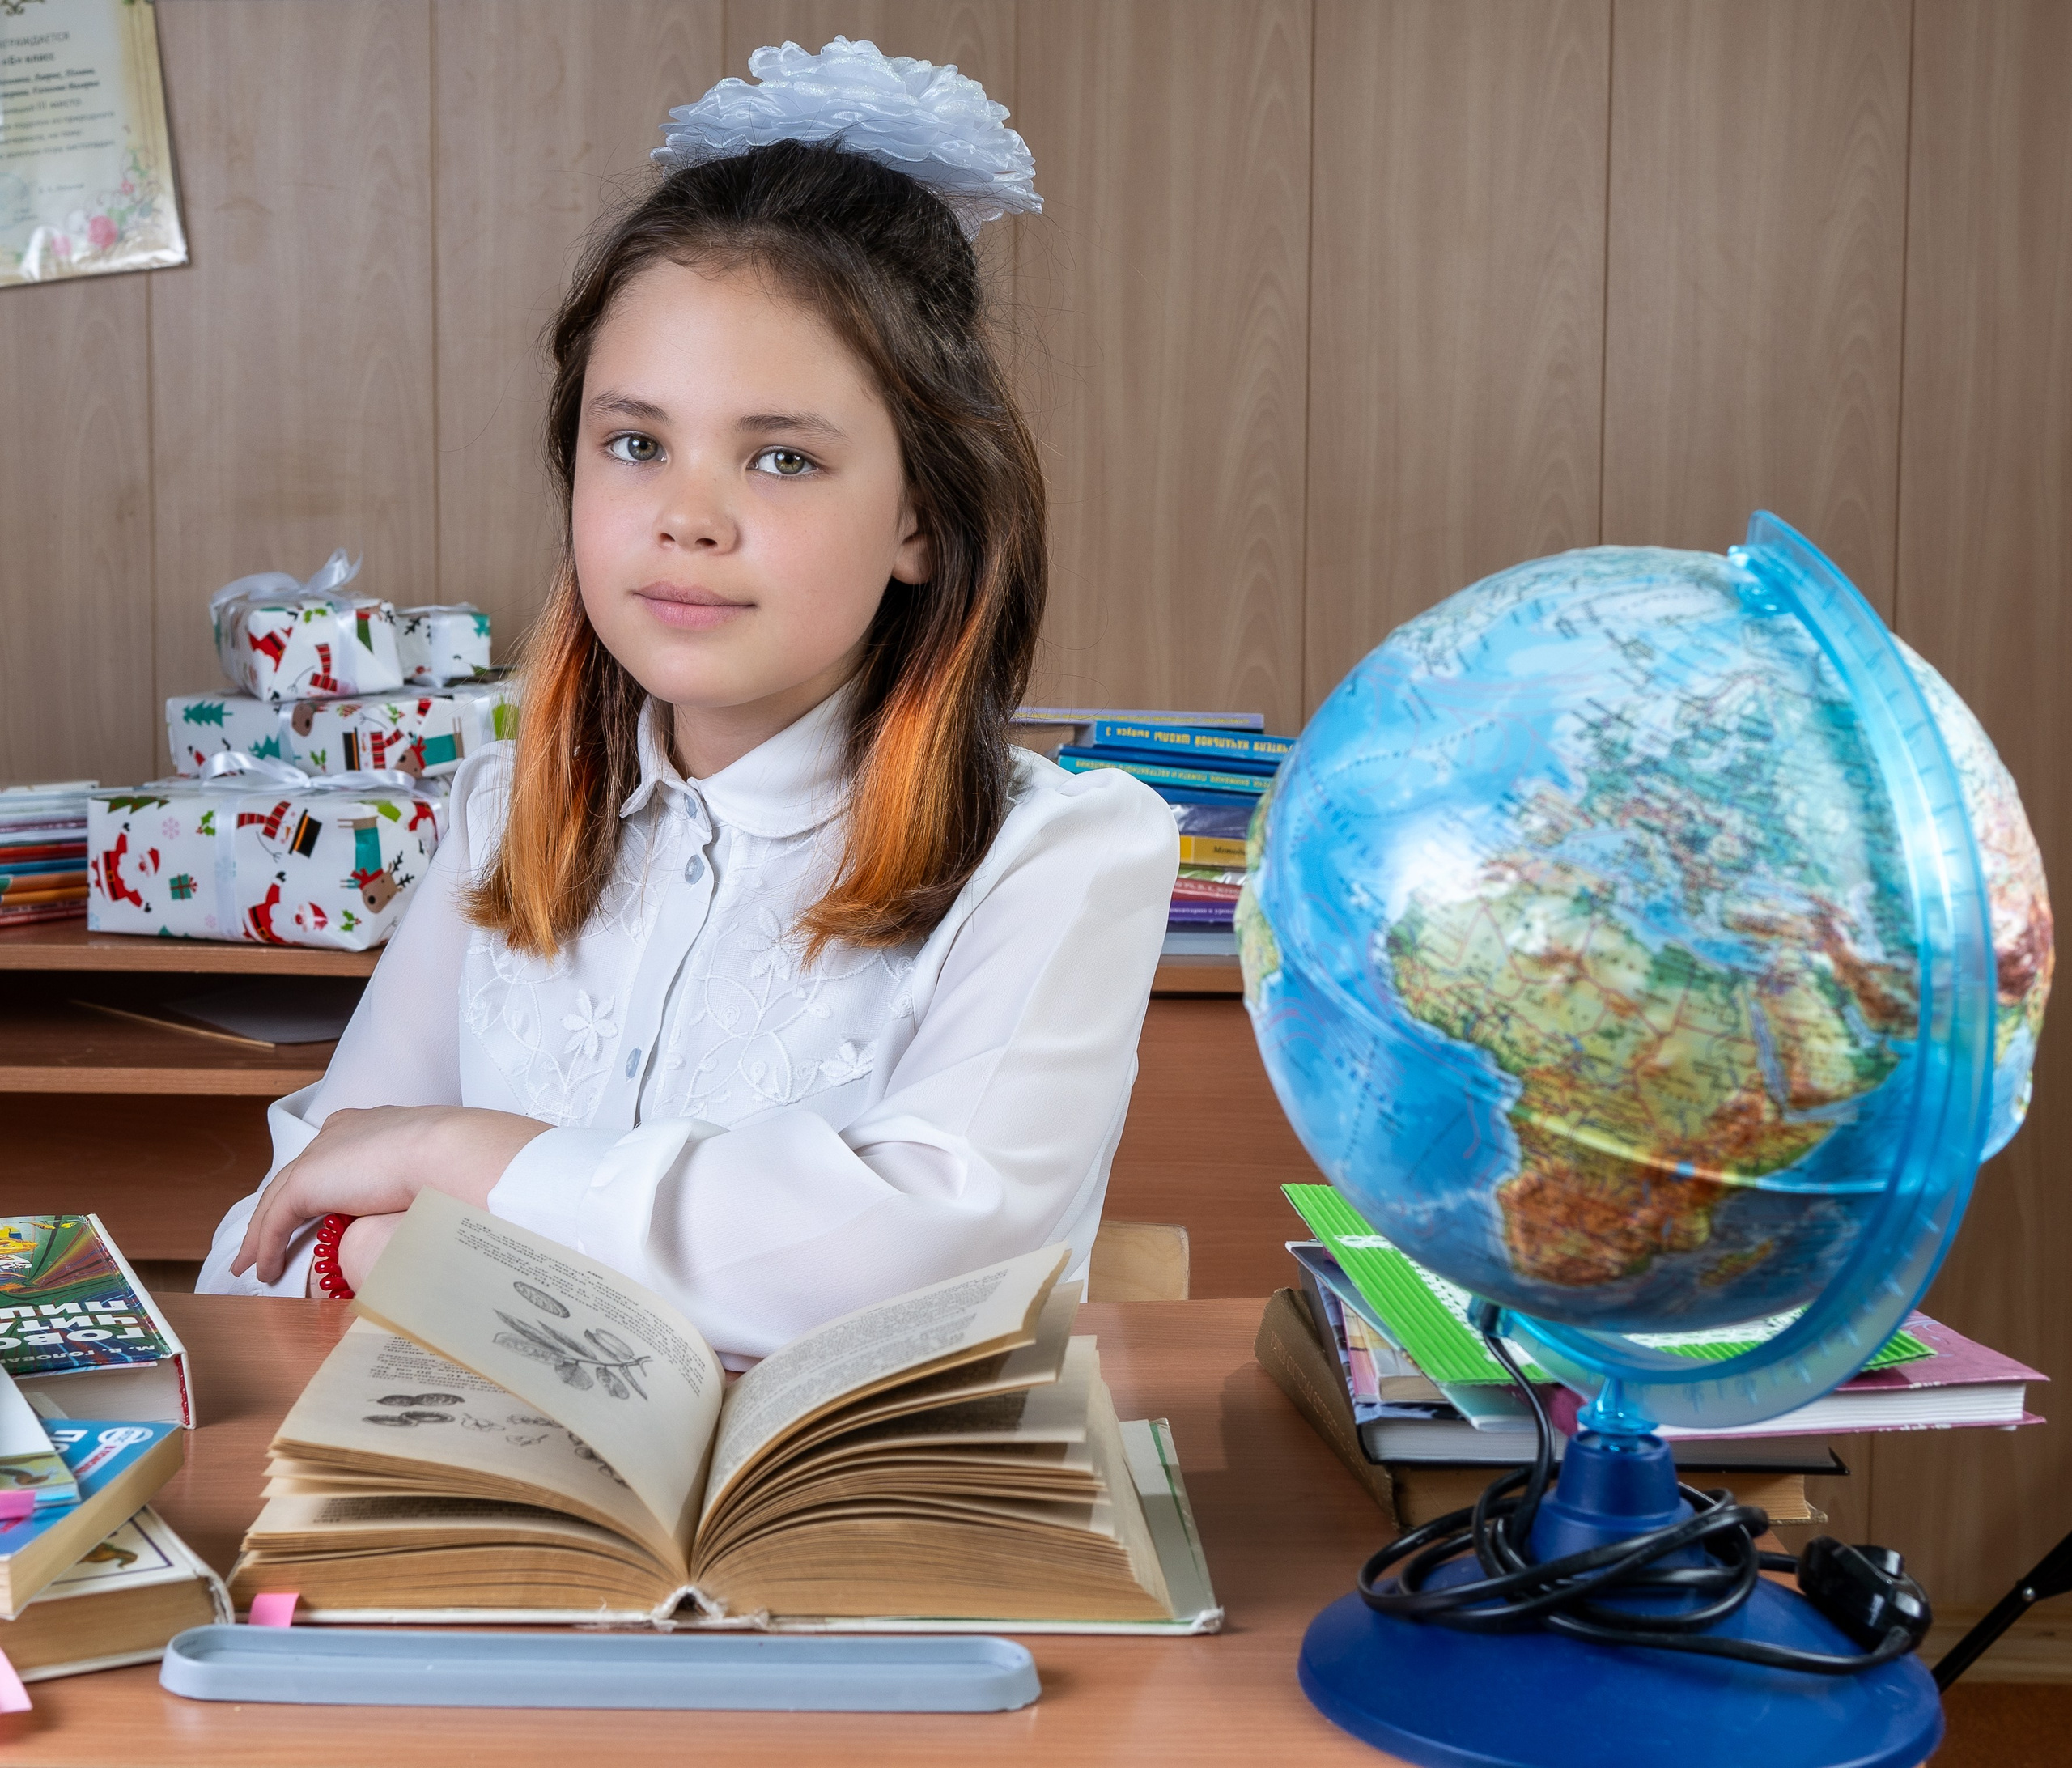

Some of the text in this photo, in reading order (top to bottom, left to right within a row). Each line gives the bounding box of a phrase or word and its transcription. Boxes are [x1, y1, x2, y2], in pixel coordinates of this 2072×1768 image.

[1116, 727, 1150, 738] выпуск
[1153, 731, 1191, 745] ШКОЛЫ
[1194, 734, 1250, 750] НАЧАЛЬНОЙ
